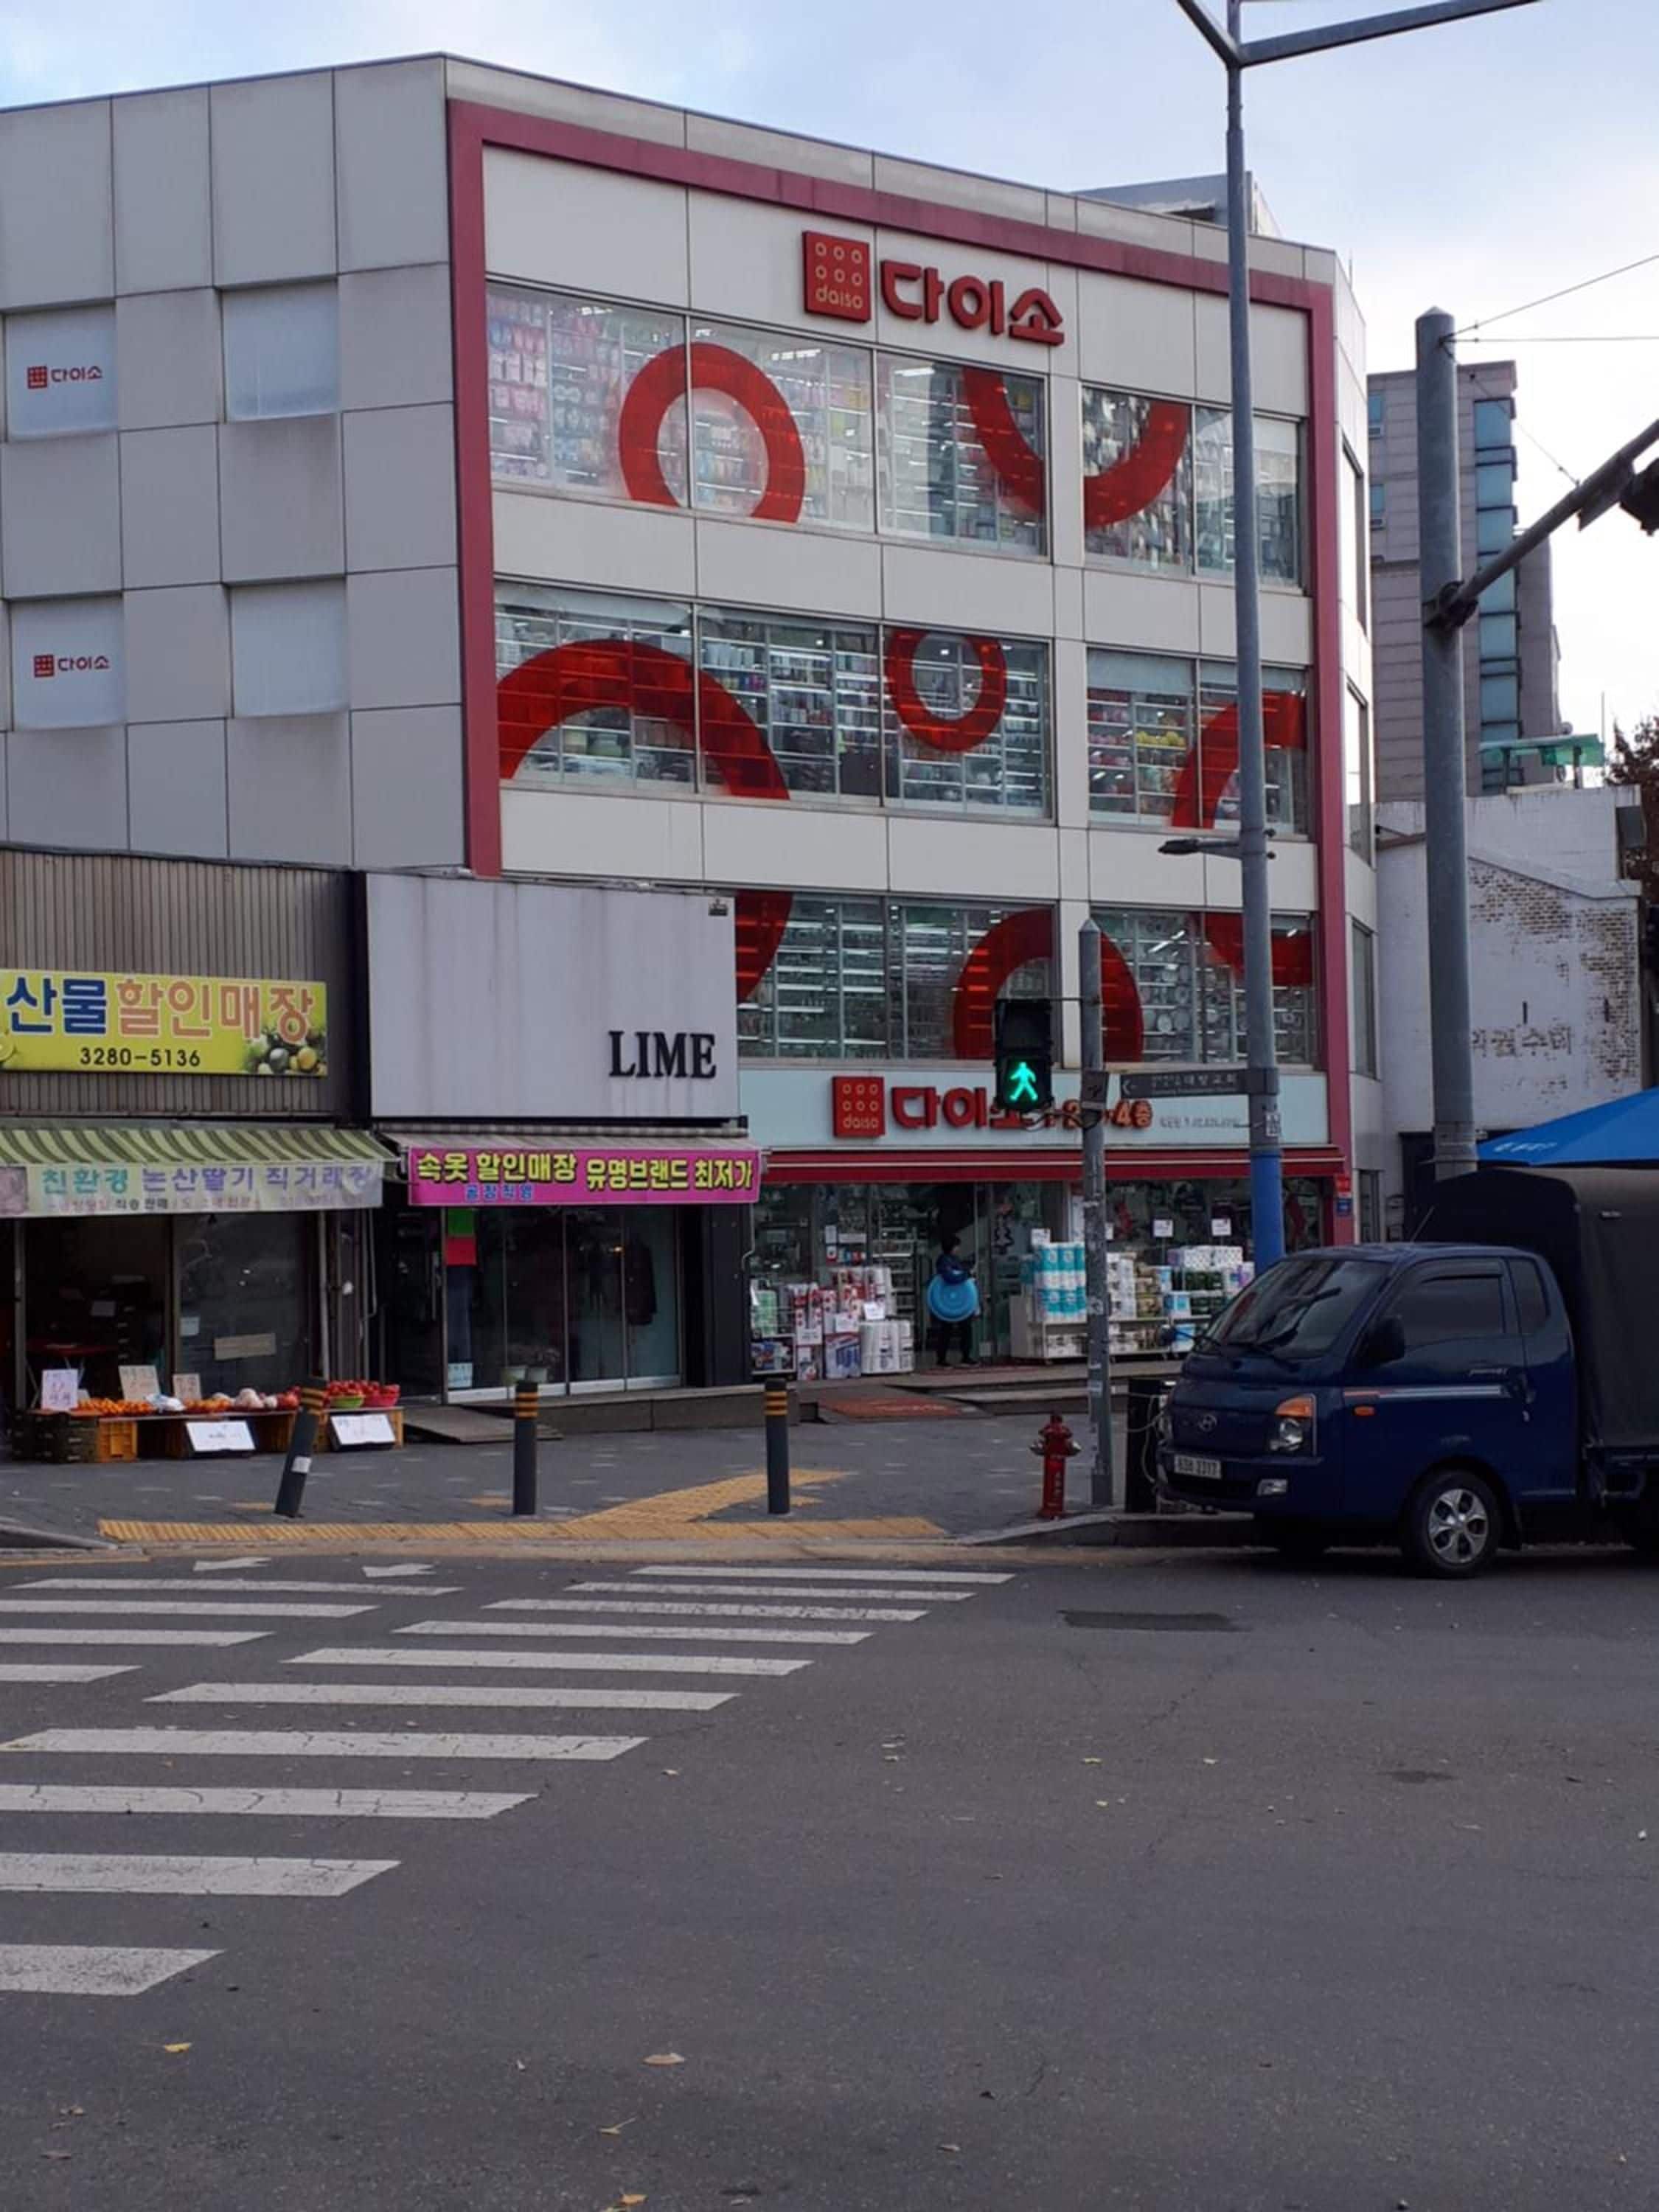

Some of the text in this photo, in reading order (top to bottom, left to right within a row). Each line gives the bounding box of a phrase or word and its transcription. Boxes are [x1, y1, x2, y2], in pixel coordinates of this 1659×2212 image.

[815, 285, 863, 310] daiso
[880, 260, 1064, 346] 다이소
[50, 366, 103, 382] 다이소
[58, 655, 110, 672] 다이소
[80, 1047, 201, 1067] 3280-5136
[608, 1031, 717, 1079] LIME
[843, 1116, 880, 1129] daiso
[42, 1167, 129, 1194] 친환경
[142, 1164, 255, 1192] 논산딸기
[417, 1152, 754, 1191] 속옷 할인매장 유명브랜드 최저가
